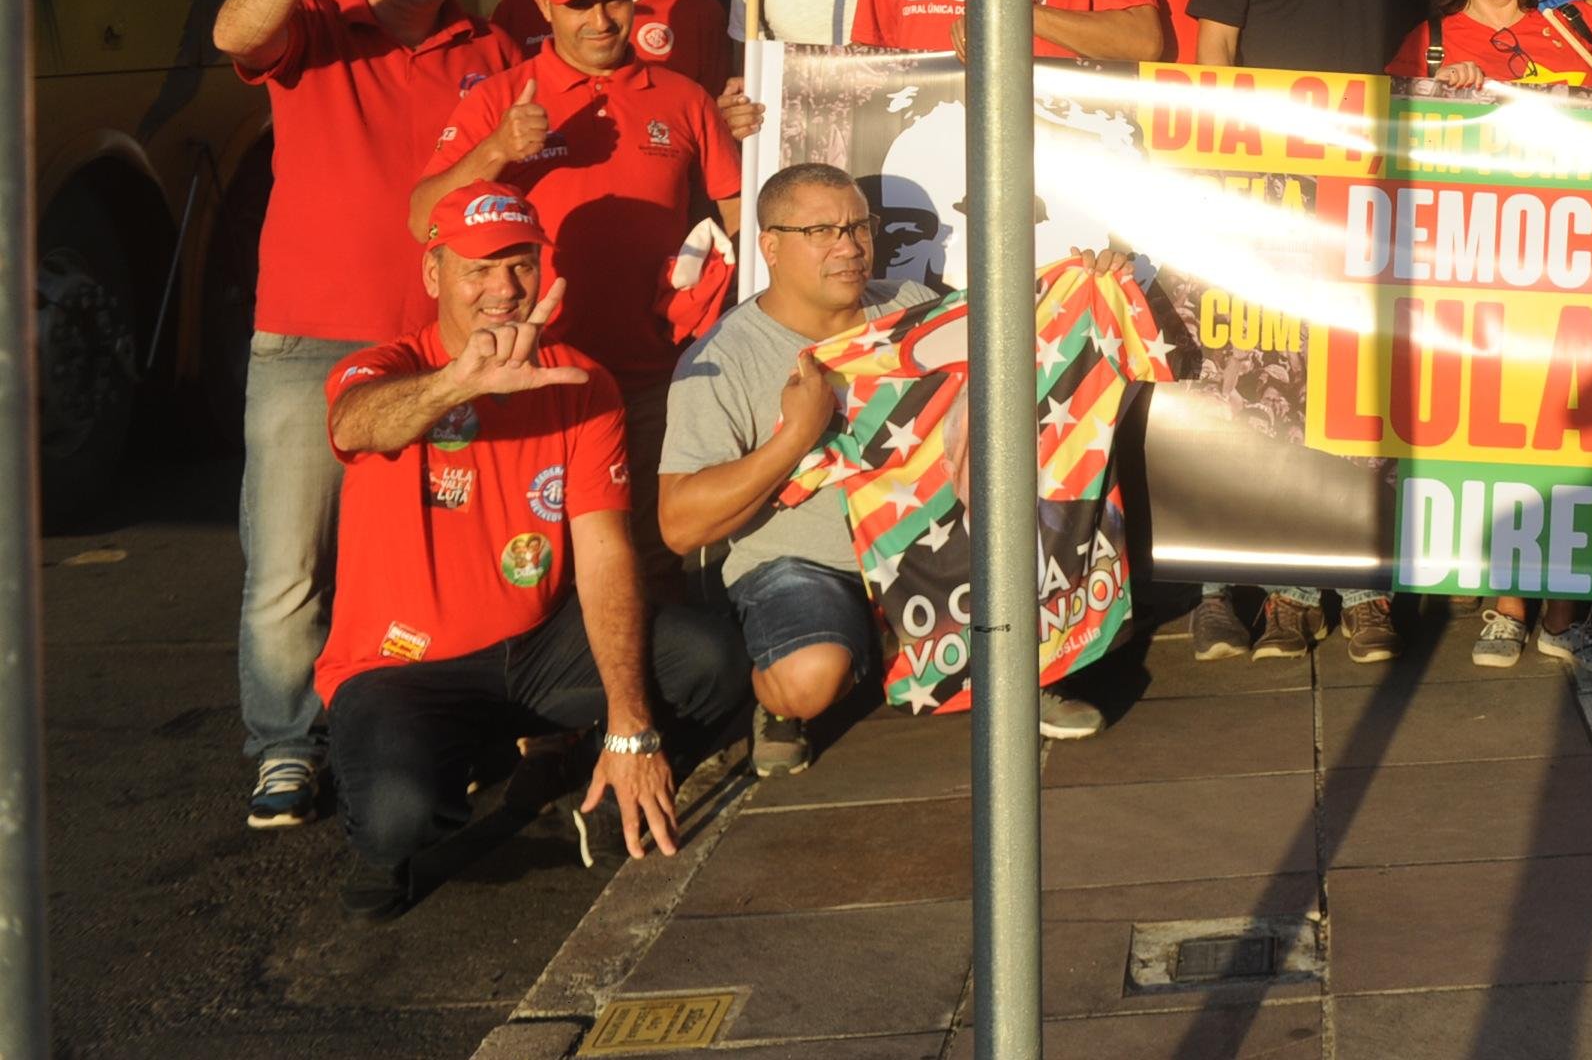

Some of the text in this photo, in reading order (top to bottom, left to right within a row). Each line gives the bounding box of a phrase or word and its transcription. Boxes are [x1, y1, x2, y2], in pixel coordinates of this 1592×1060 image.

[1152, 68, 1263, 156] DIA
[1397, 111, 1463, 174] EM
[1199, 288, 1301, 352] COM
[443, 467, 473, 483] LULA
[437, 489, 468, 504] LUTA
